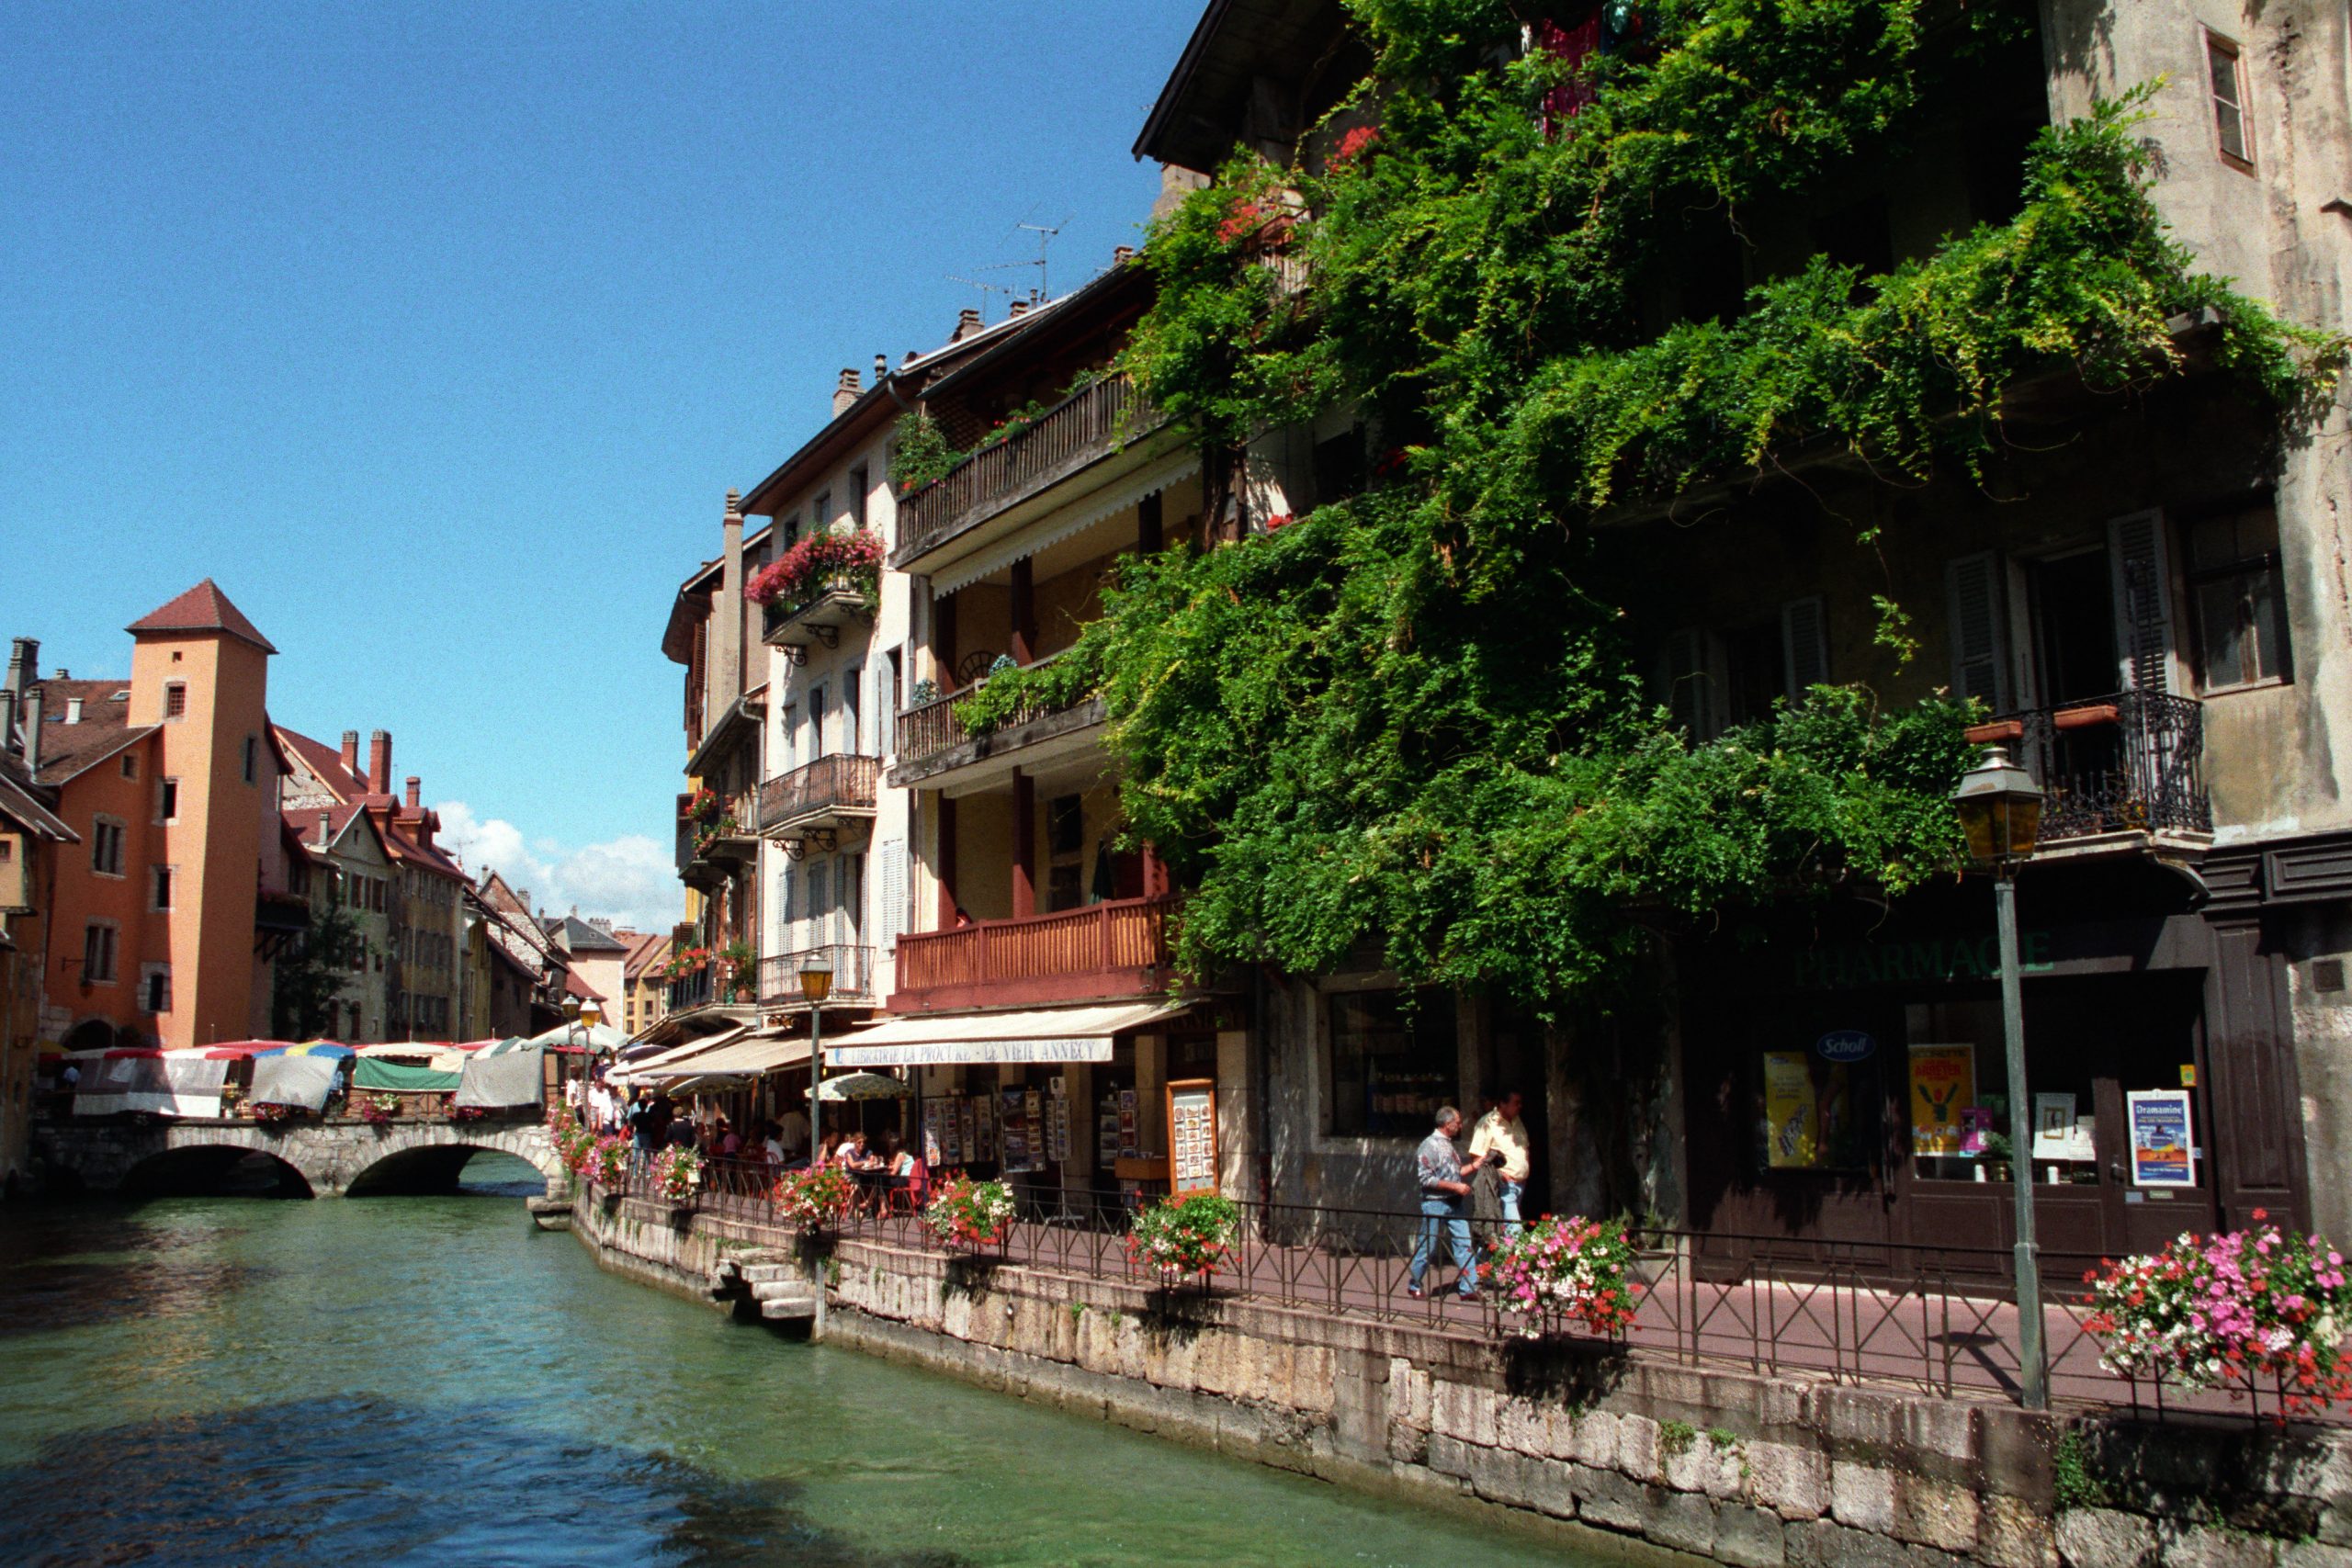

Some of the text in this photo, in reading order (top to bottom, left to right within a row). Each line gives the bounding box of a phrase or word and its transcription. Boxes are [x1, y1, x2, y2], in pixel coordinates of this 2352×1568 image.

[1793, 931, 2053, 986] PHARMACE
[852, 1049, 899, 1064] LIBRAIRIE
[903, 1047, 915, 1063] LA
[920, 1044, 970, 1062] PROCURE
[985, 1043, 997, 1061] LE
[1041, 1041, 1095, 1060] ANNECY
[1825, 1037, 1867, 1054] Scholl
[2136, 1104, 2182, 1114] Dramamine
